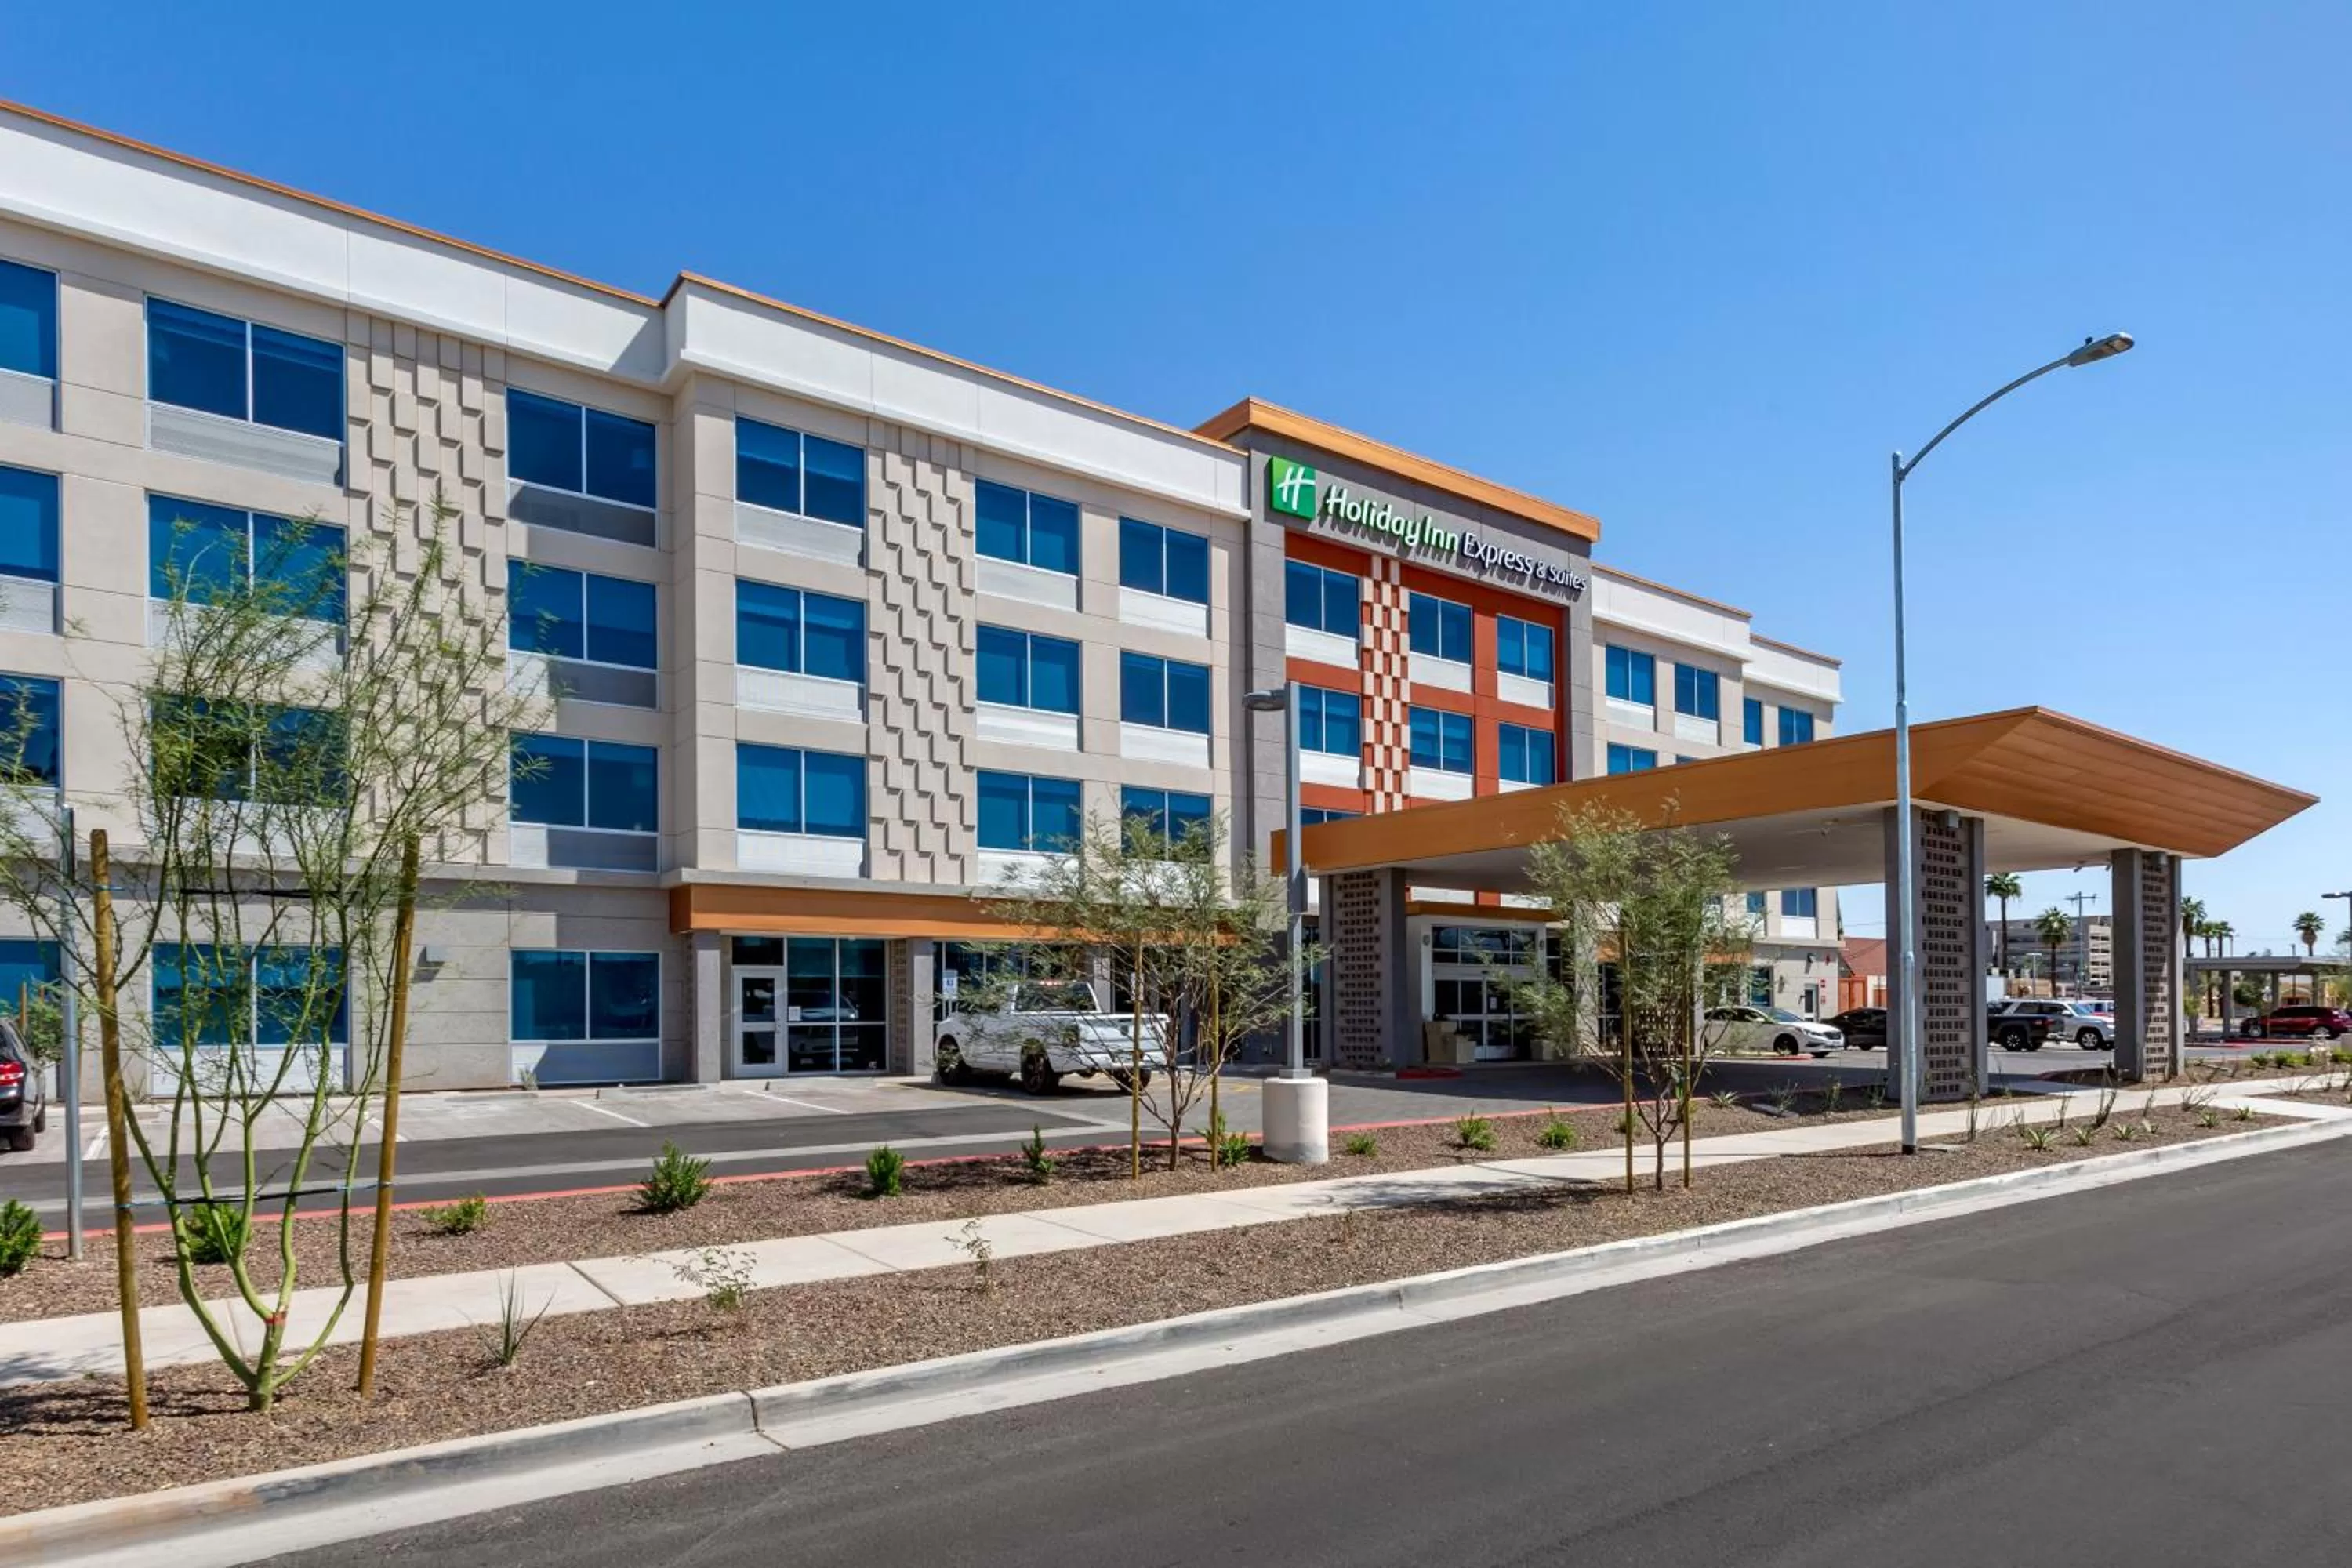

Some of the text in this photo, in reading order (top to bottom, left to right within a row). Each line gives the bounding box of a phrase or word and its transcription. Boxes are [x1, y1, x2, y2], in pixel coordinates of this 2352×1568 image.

[1276, 466, 1315, 510] H
[1326, 485, 1588, 590] Holiday Inn Express & Suites
